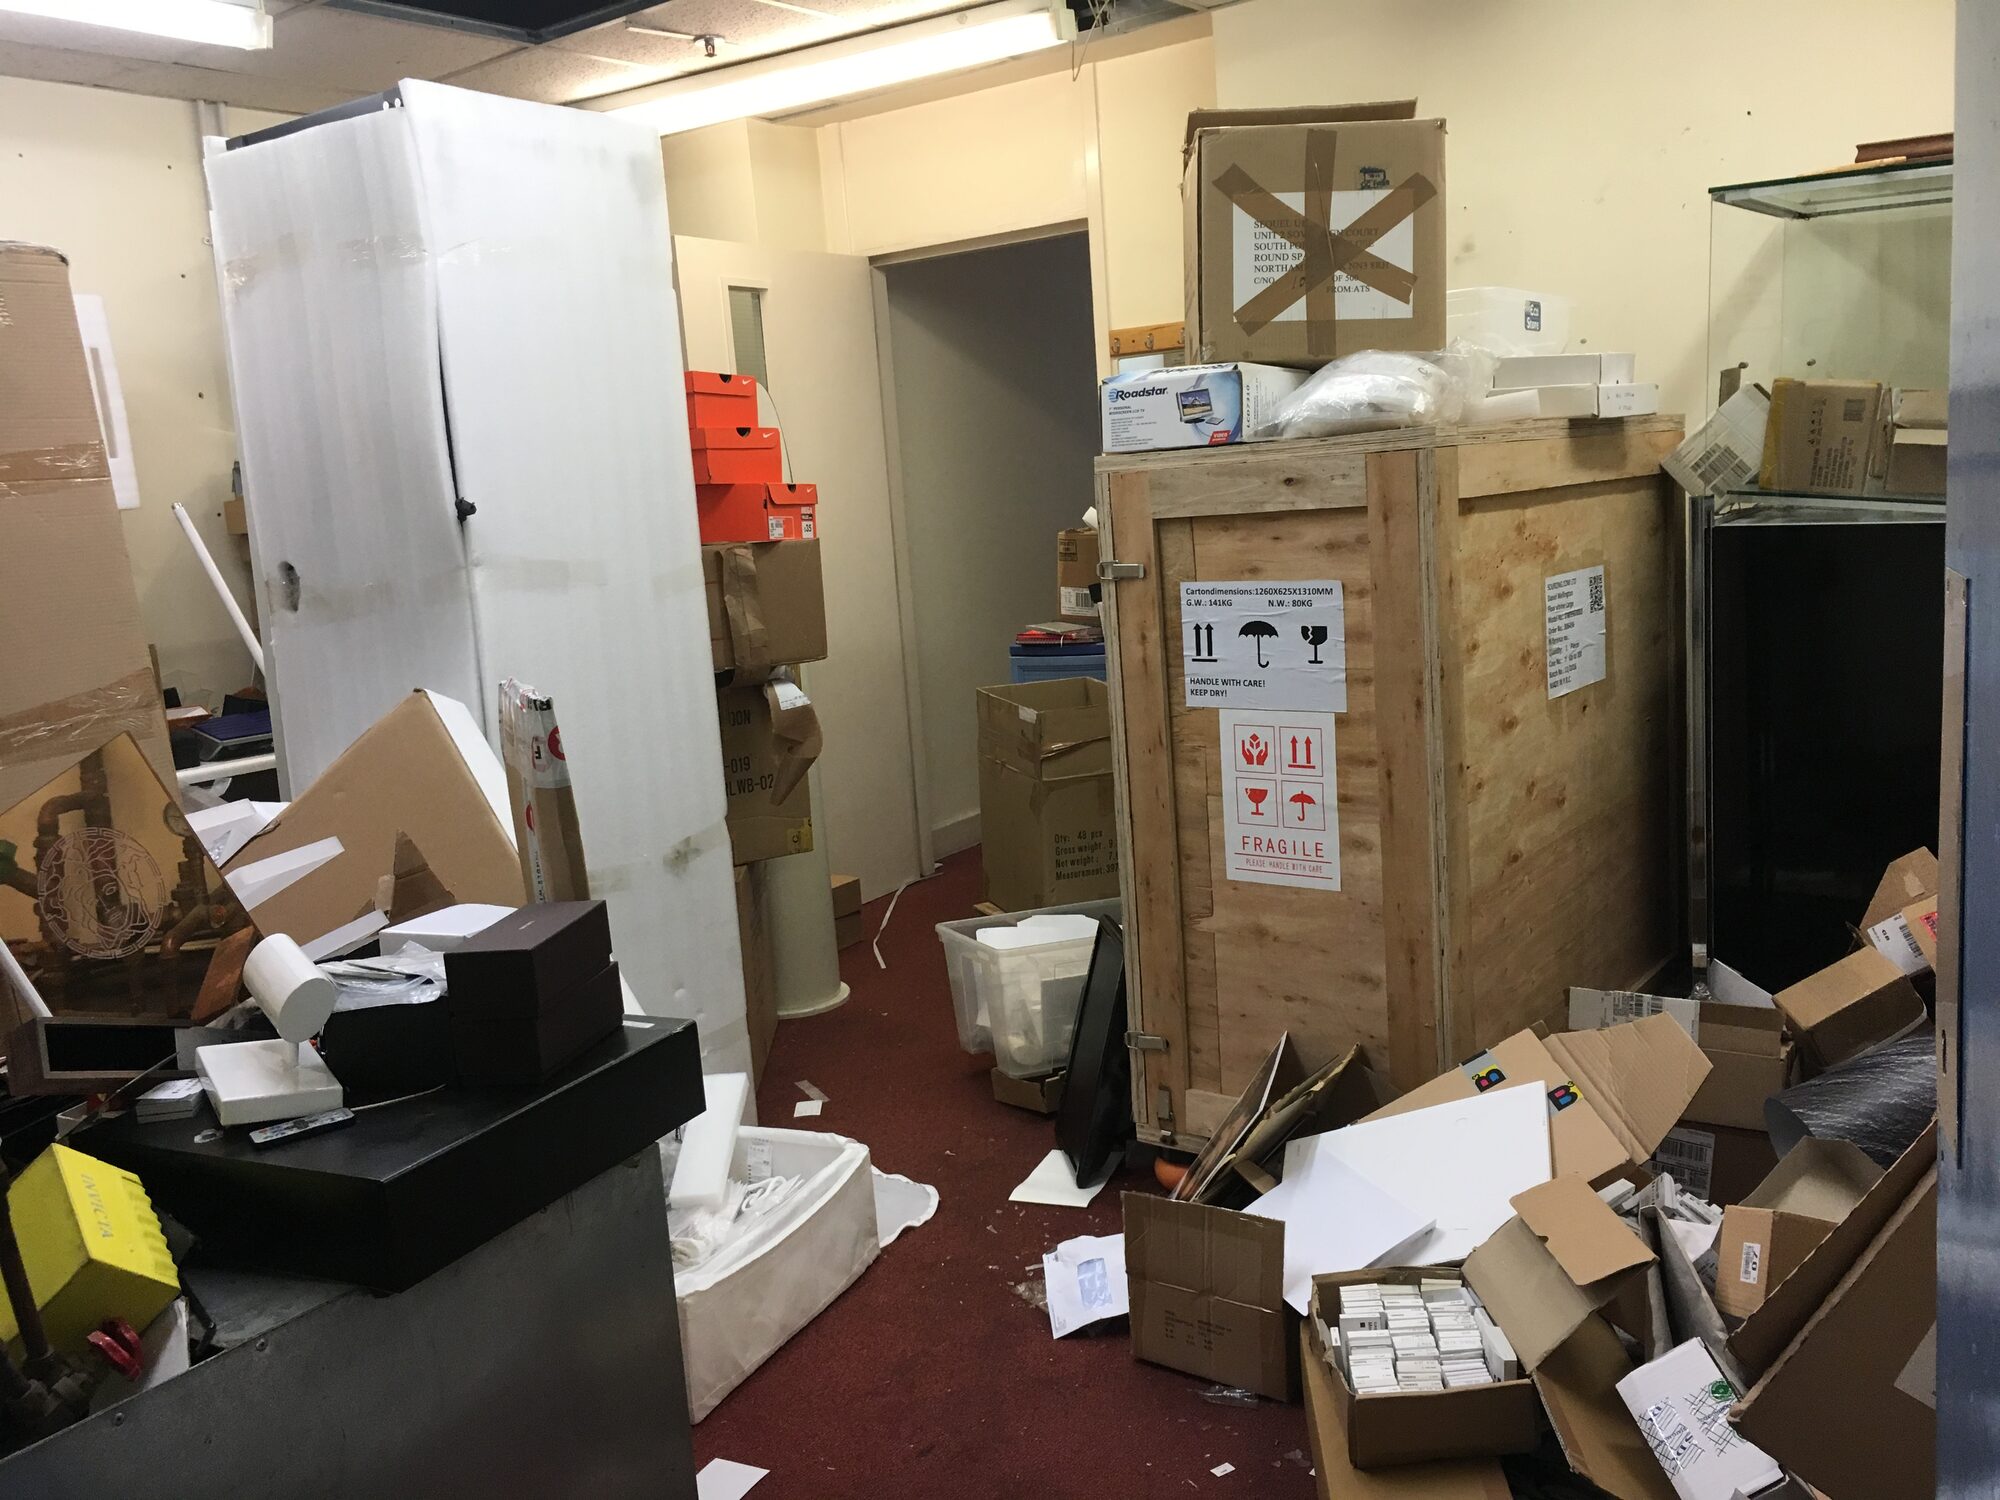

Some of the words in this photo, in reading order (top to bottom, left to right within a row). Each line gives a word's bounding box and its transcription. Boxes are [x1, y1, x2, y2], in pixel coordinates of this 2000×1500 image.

[1254, 231, 1277, 240] UNIT
[1254, 242, 1287, 251] SOUTH
[1254, 253, 1289, 262] ROUND
[1116, 387, 1168, 401] Roadstar
[1208, 599, 1233, 607] 141KG
[1291, 599, 1313, 607] 80KG
[1190, 677, 1220, 686] HANDLE
[1220, 678, 1241, 687] WITH
[1242, 679, 1266, 688] CARE!
[1190, 688, 1209, 697] KEEP
[1209, 689, 1228, 698] DRY!
[1055, 846, 1076, 856] Gross
[1241, 835, 1325, 858] FRAGILE
[1055, 859, 1068, 868] Net
[1245, 858, 1266, 868] PLEASE
[1269, 861, 1289, 871] HANDLE
[1292, 863, 1307, 872] WITH
[1308, 864, 1323, 874] CARE
